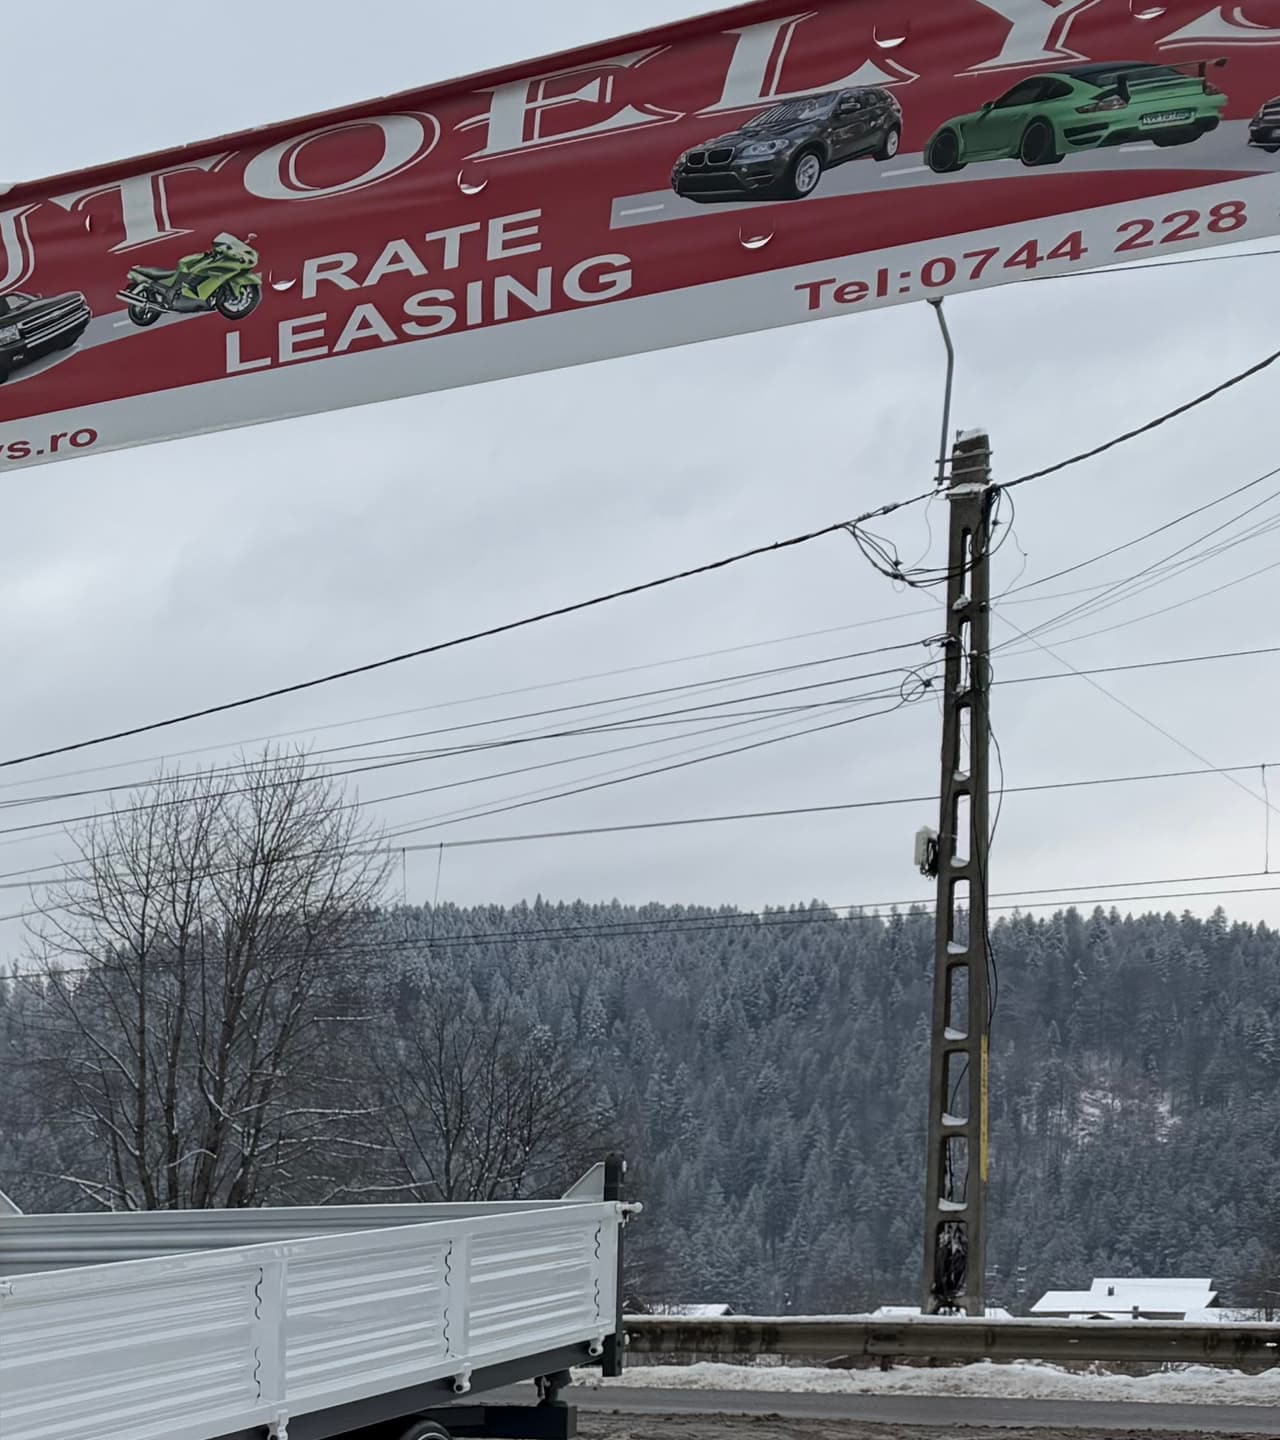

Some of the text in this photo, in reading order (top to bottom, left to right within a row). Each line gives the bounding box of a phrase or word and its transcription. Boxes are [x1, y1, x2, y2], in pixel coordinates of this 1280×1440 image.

[302, 208, 542, 299] RATE
[794, 200, 1248, 311] Tel:0744 228
[226, 253, 632, 374] LEASING
